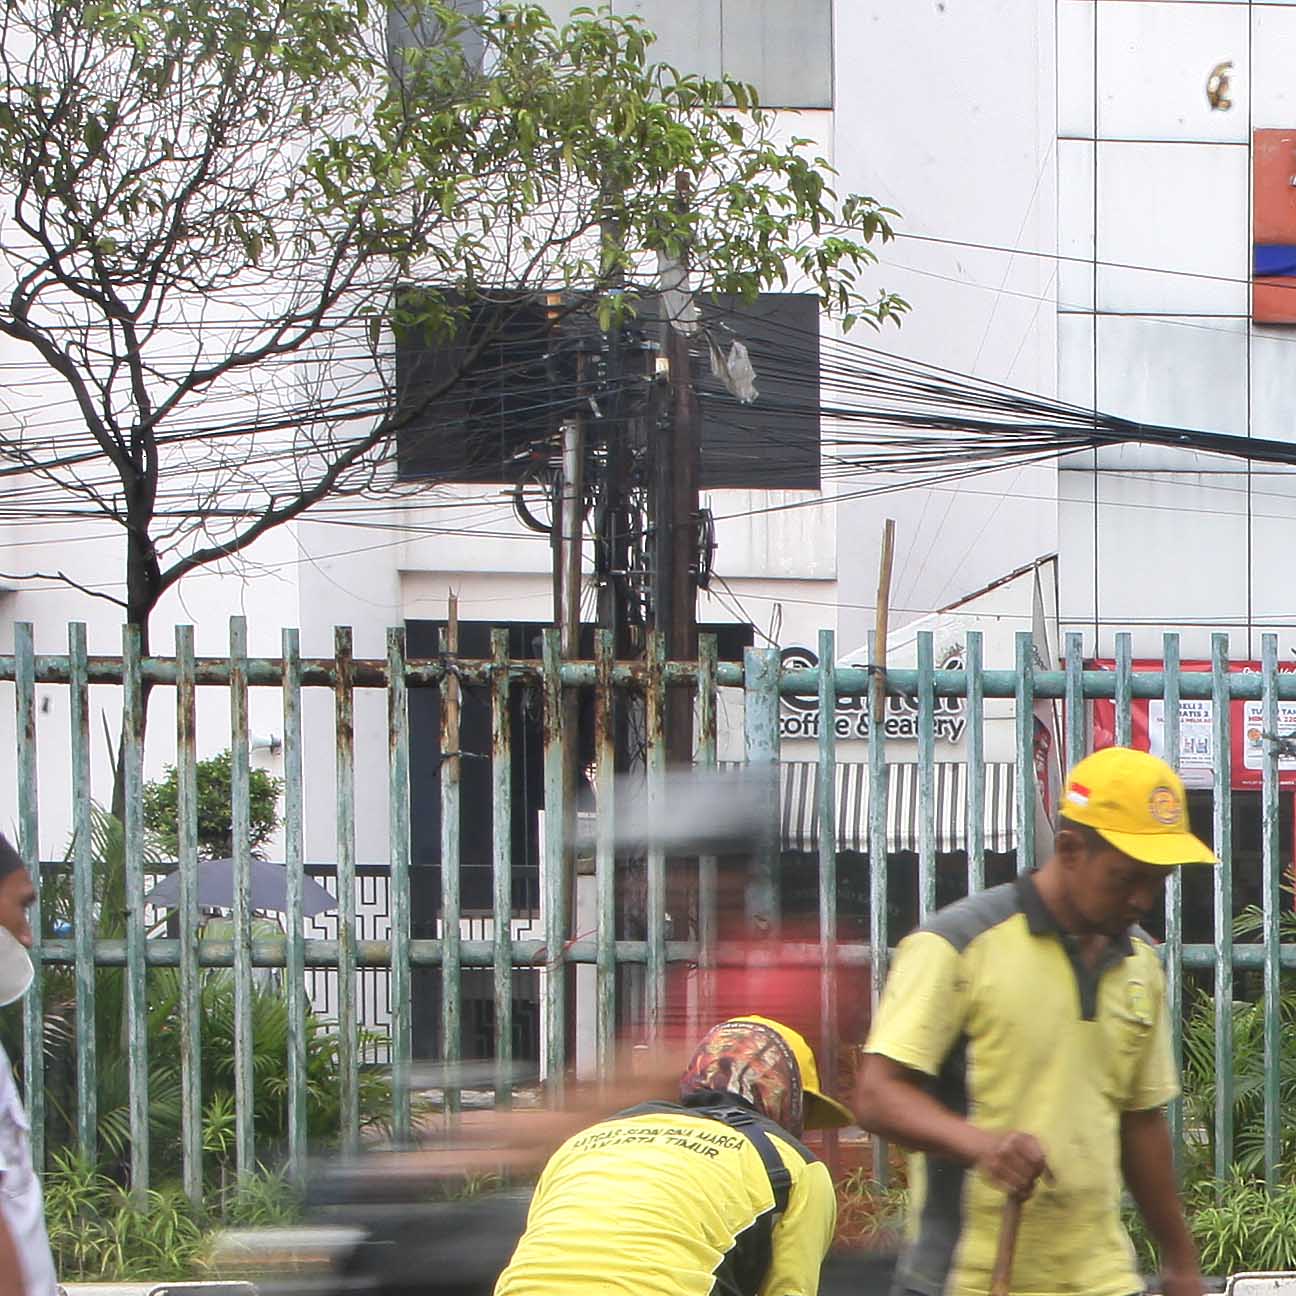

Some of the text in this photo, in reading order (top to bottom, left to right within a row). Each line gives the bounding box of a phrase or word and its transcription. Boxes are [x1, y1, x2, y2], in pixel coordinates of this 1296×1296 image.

[778, 712, 849, 735] coffe
[885, 715, 965, 741] eatry
[665, 1137, 720, 1160] TIMUR
[695, 1131, 745, 1151] MARGA
